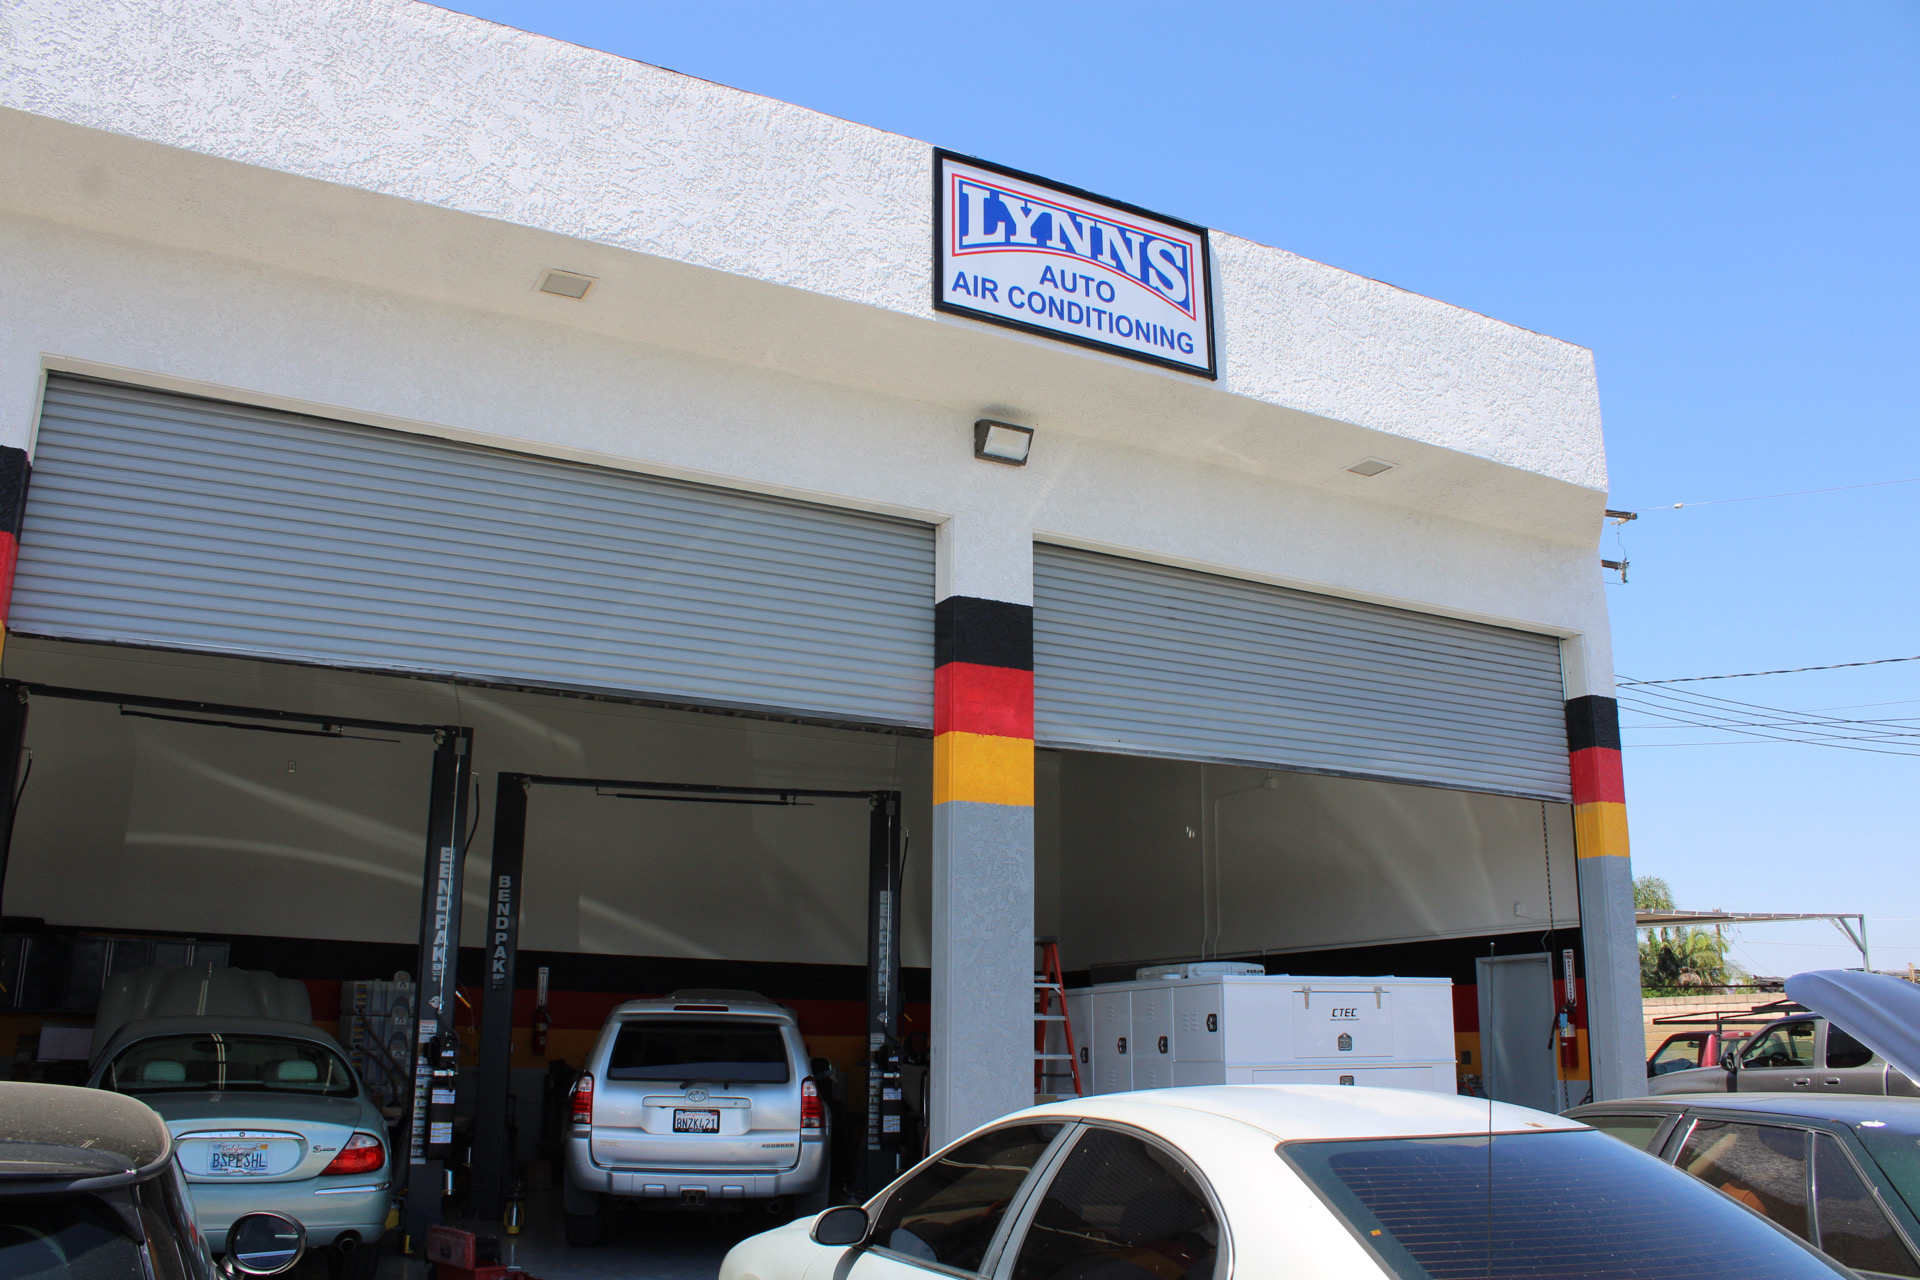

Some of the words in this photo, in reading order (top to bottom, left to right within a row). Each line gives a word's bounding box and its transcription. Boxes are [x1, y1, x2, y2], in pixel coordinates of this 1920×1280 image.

[962, 183, 1187, 303] LYNNS
[1039, 265, 1116, 303] AUTO
[952, 271, 999, 302] AIR
[1008, 286, 1194, 354] CONDITIONING
[493, 875, 511, 972] BENDPAK
[1332, 1008, 1357, 1017] CTEC
[676, 1118, 715, 1129] 8NZK421
[212, 1153, 266, 1168] BSPESHL
[221, 1143, 257, 1154] California
